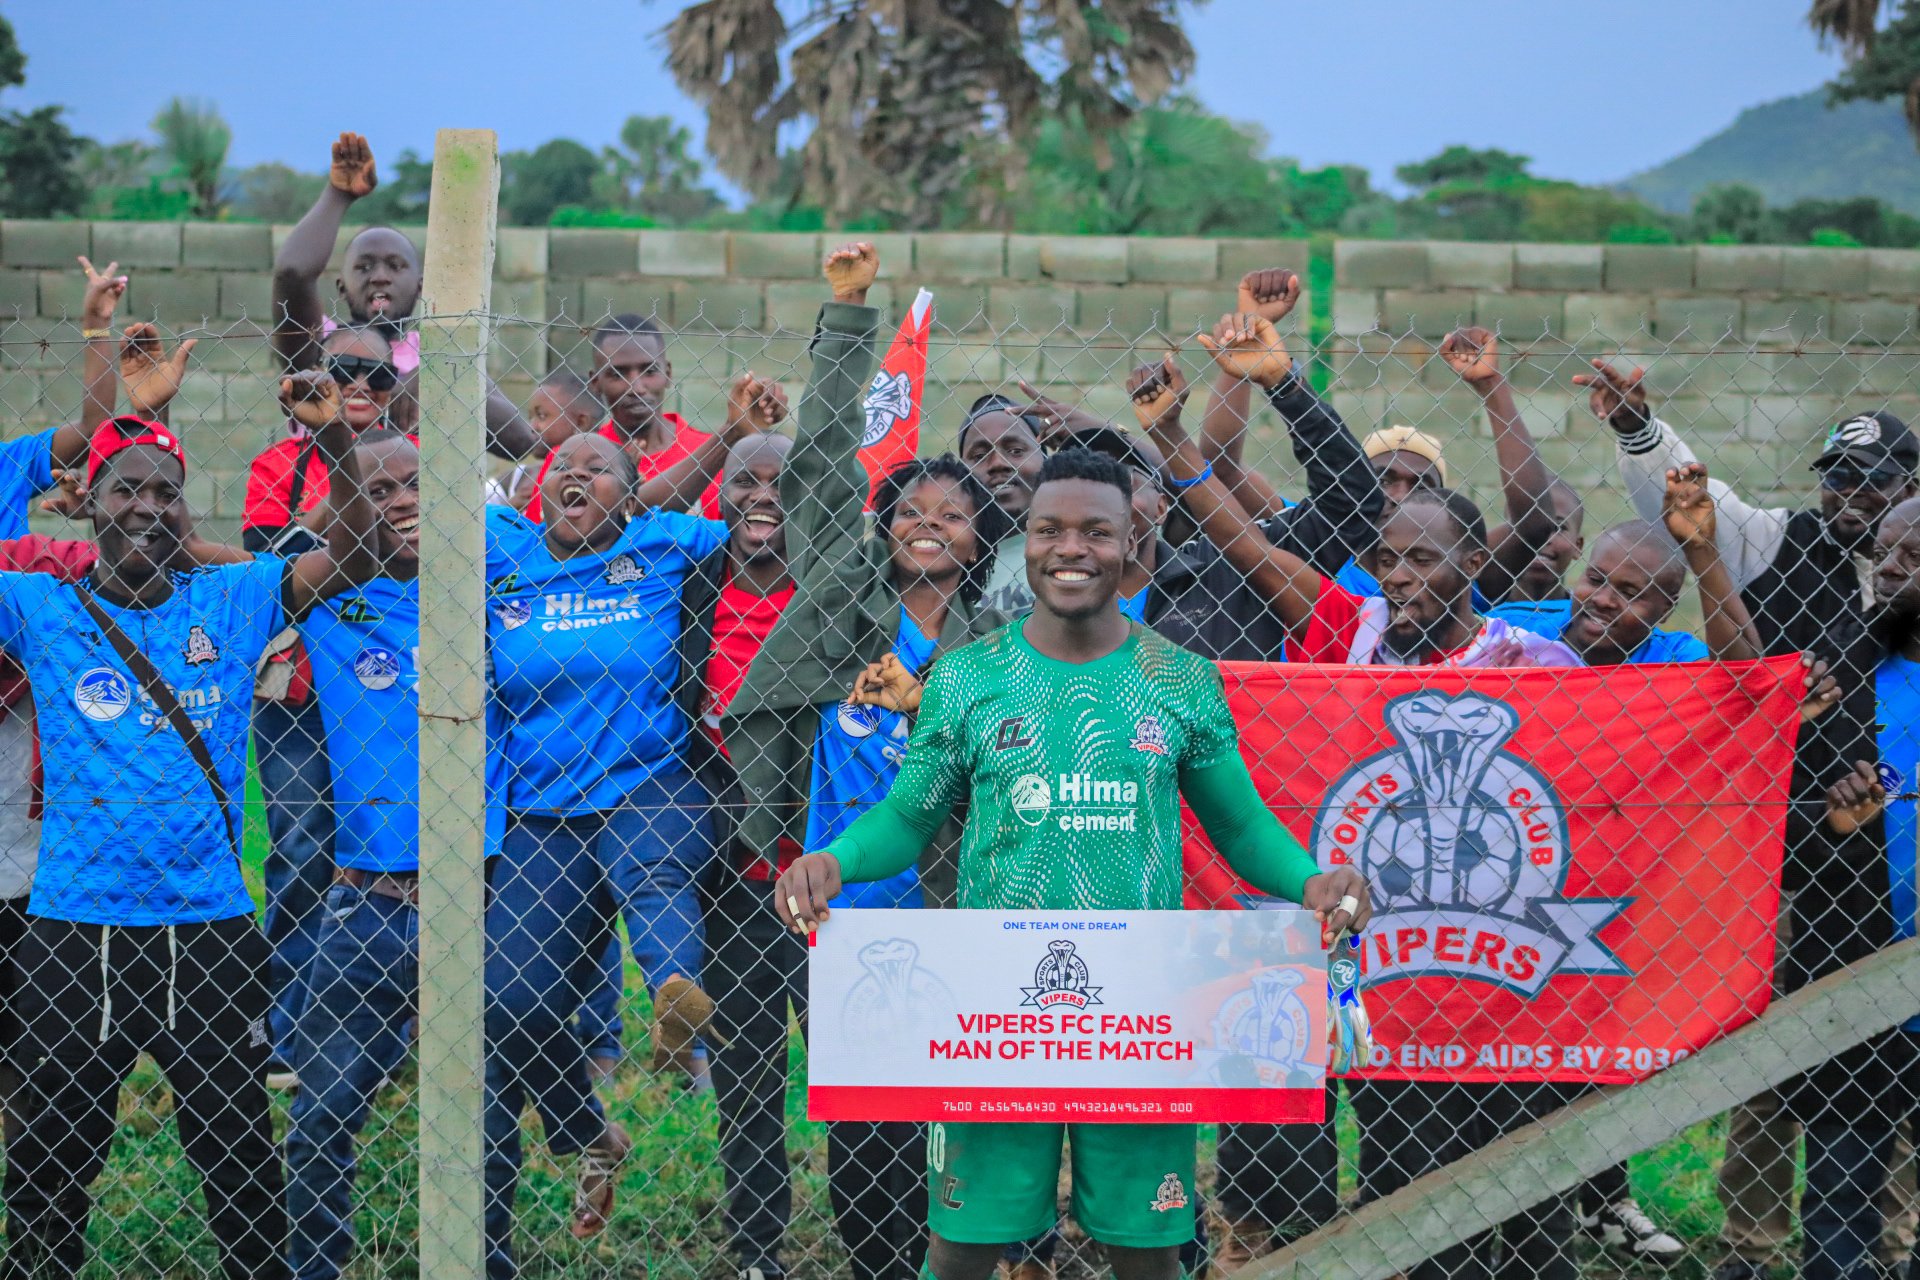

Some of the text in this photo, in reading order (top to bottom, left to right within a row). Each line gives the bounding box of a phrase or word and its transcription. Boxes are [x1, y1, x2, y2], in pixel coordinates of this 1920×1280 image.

[865, 422, 885, 441] CLU
[1059, 773, 1138, 802] Hima
[1059, 810, 1136, 831] cement
[1330, 774, 1553, 866] PORTS CLUB
[1003, 921, 1127, 931] ONE TEAM ONE DREAM
[1039, 959, 1086, 985] SPORTS CLUB
[1041, 993, 1084, 1006] VIPERS
[957, 1014, 1172, 1035] VIPERS FC FANS
[929, 1040, 1193, 1060] MAN OF THE MATCH
[1401, 1045, 1459, 1067] END
[1475, 1045, 1552, 1068] AIDS
[1561, 1046, 1605, 1069] BY
[942, 1102, 972, 1111] 7600
[1170, 1103, 1193, 1112] 000
